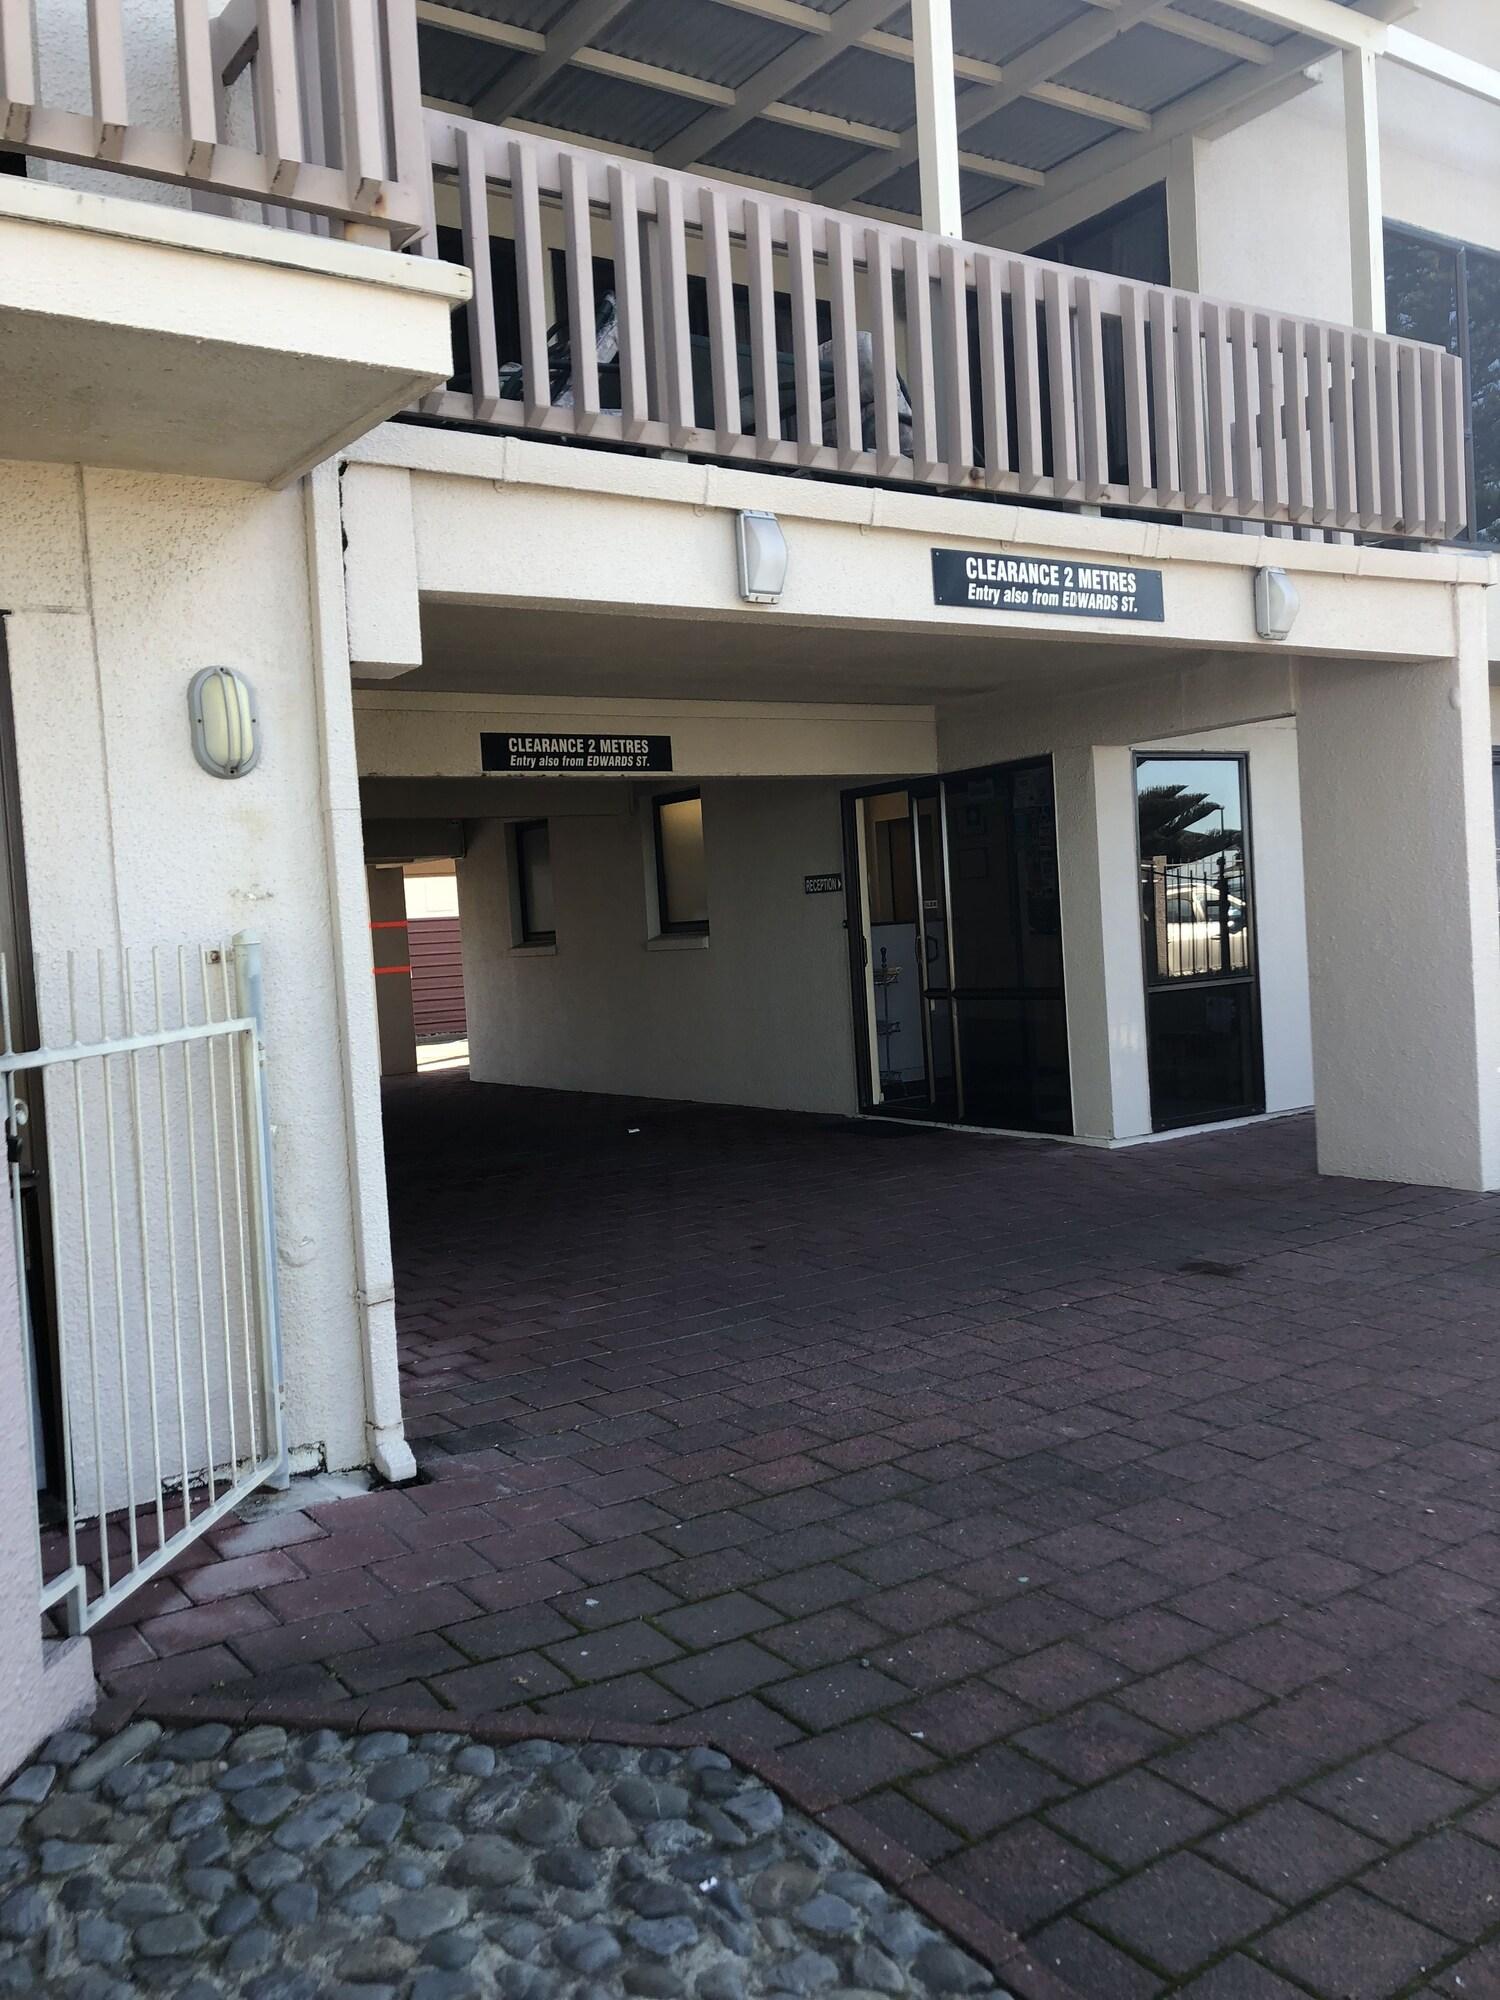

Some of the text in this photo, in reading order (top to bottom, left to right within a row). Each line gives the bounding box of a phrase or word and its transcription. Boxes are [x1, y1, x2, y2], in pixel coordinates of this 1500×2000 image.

[966, 557, 1136, 593] CLEARANCE 2 METRES
[968, 583, 1138, 613] Entry also from EDWARDS ST.
[508, 737, 649, 754] CLEARANCE 2 METRES
[510, 755, 650, 768] Entry also from EDWARDS ST.
[806, 877, 836, 891] RECEPTION
